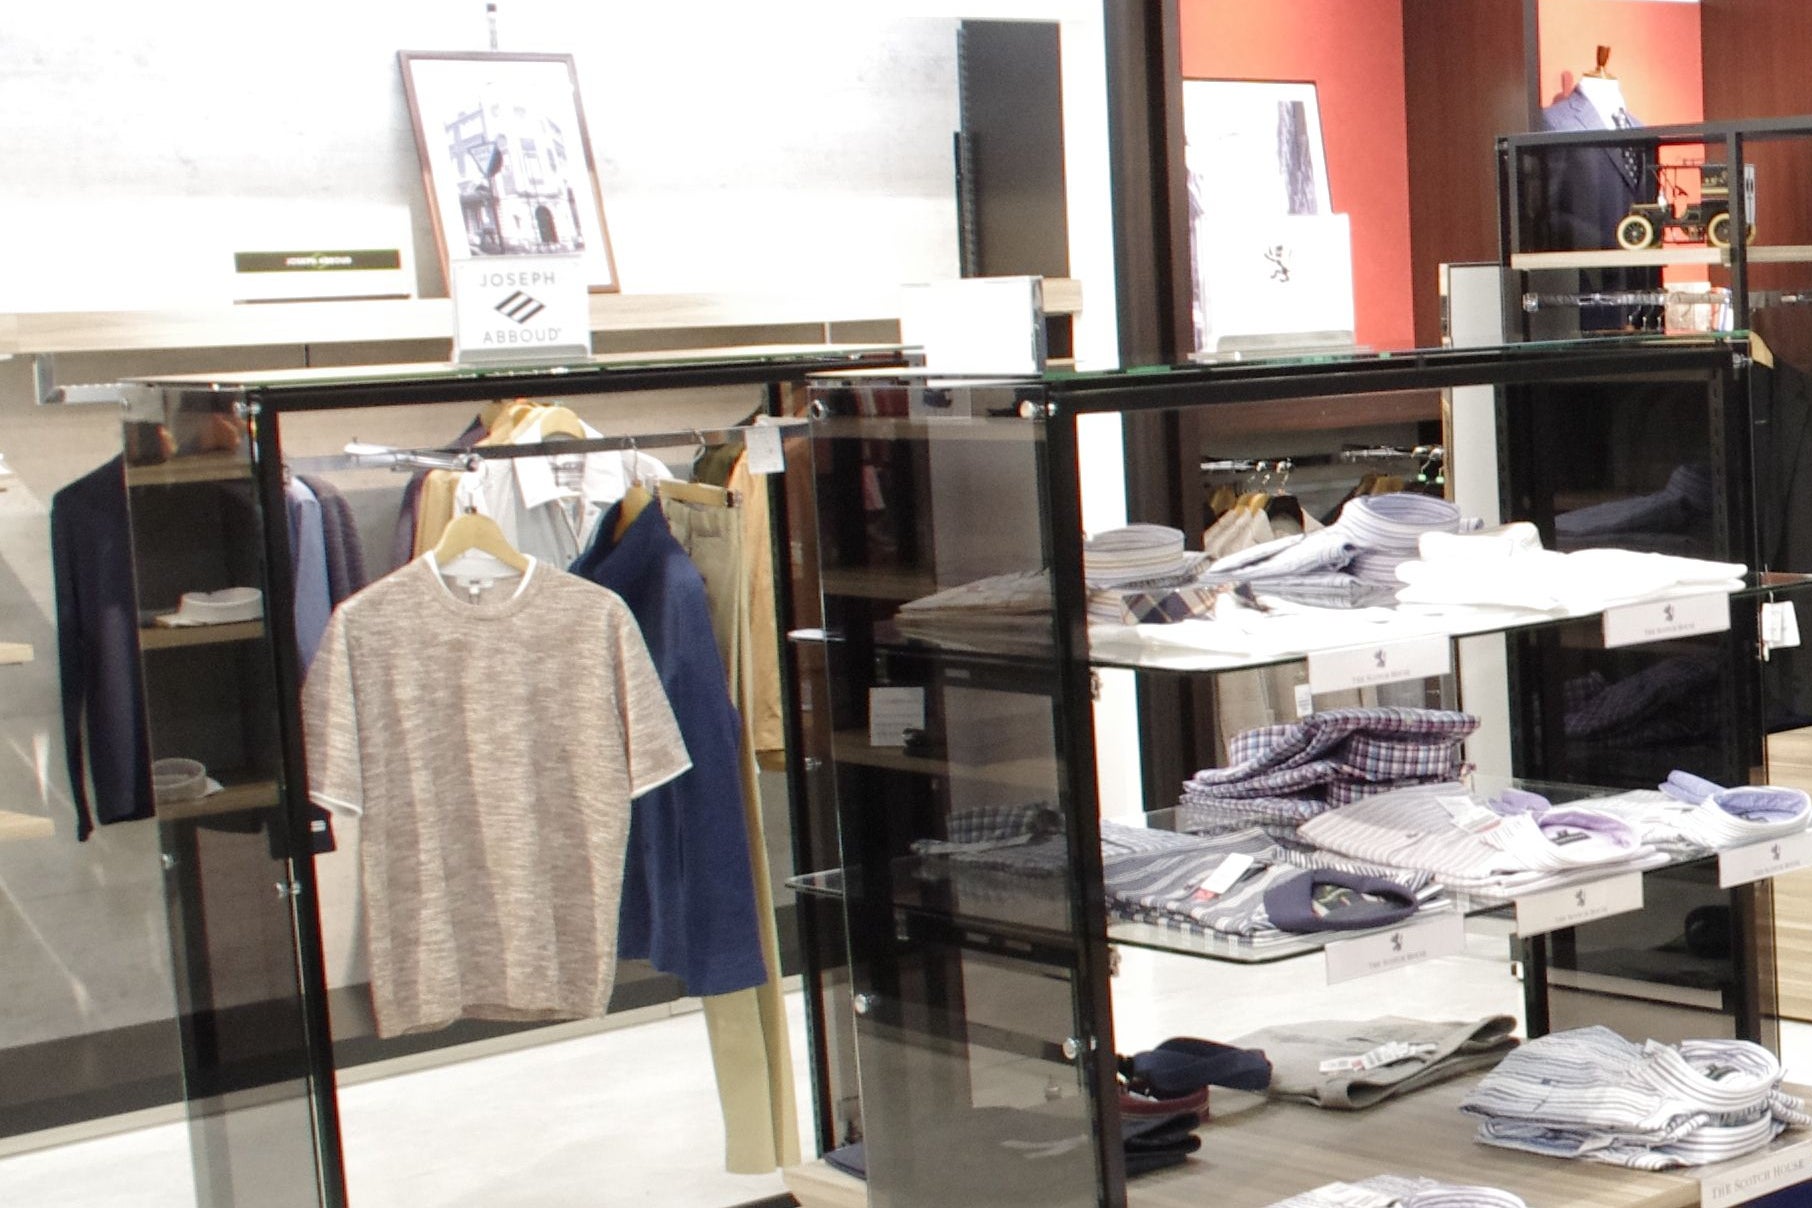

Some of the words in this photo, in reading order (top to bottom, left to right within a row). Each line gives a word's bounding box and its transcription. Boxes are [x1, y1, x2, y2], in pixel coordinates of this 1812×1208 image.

[480, 271, 556, 287] JOSEPH
[1712, 1183, 1730, 1199] THE
[1734, 1168, 1770, 1190] SCOTCH
[1773, 1158, 1805, 1177] HOUSE
